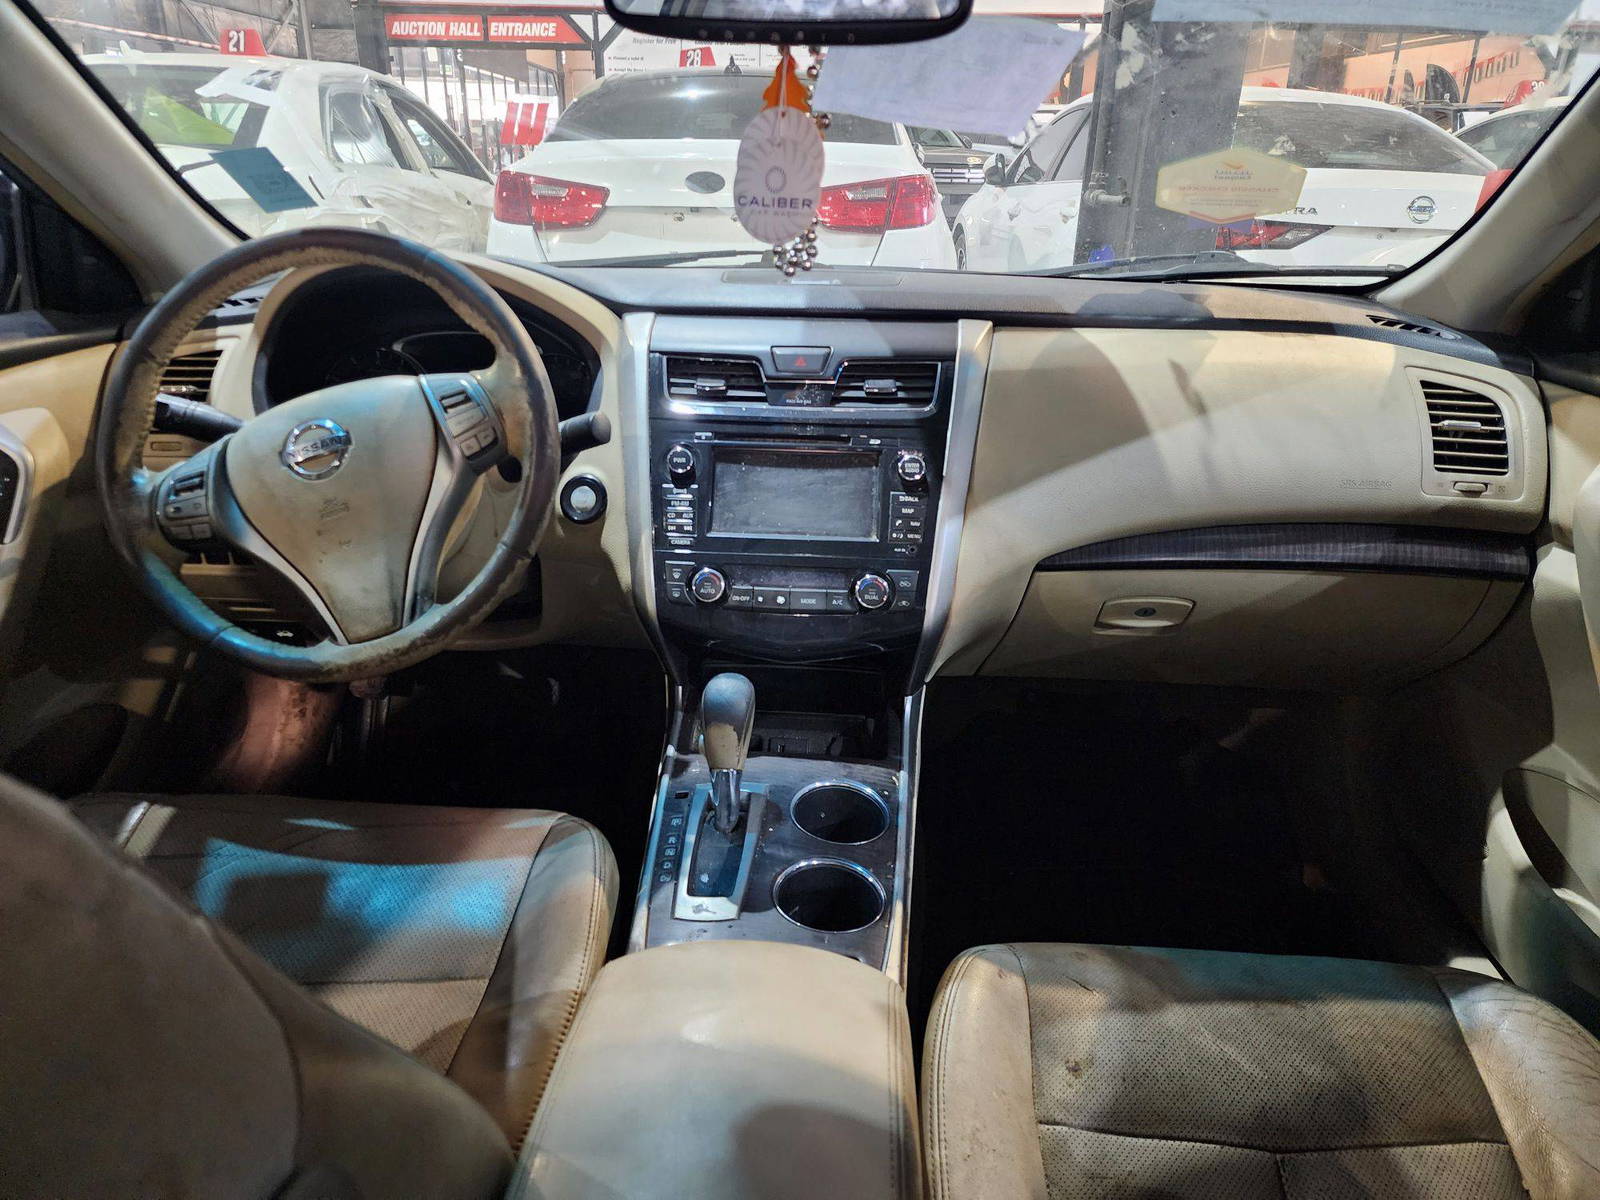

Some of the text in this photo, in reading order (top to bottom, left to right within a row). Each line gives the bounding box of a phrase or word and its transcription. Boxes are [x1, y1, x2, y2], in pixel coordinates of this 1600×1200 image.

[391, 20, 481, 36] AUCTION HALL
[490, 21, 557, 37] ENTRANCE
[228, 30, 245, 52] 21
[686, 49, 702, 67] 28
[737, 195, 813, 209] CALIBER
[700, 587, 716, 595] AUTO
